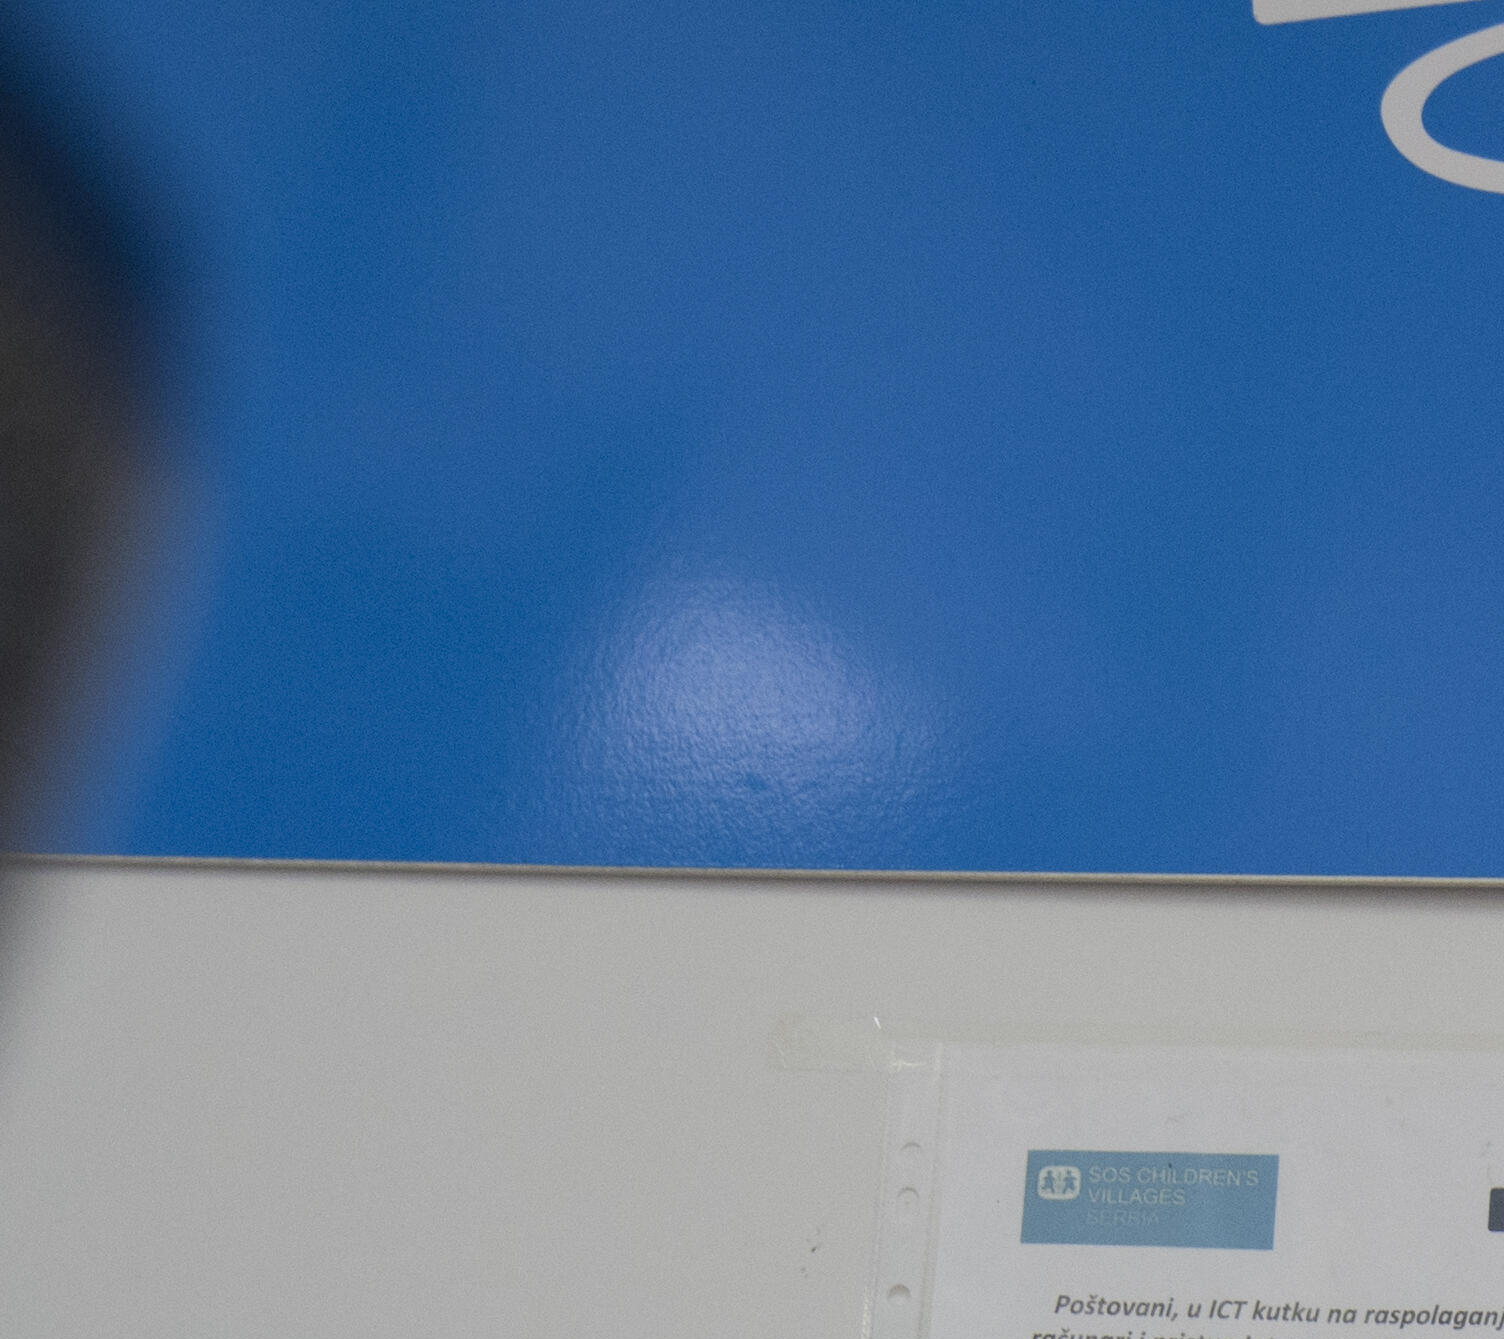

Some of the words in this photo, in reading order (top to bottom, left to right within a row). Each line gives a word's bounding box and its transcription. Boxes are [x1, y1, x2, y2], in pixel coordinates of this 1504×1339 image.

[1087, 1165, 1133, 1184] SOS
[1087, 1187, 1187, 1206] VILLAGES
[1054, 1292, 1181, 1323] Poštovani,
[1186, 1302, 1204, 1321] u
[1208, 1297, 1248, 1321] ICT
[1251, 1298, 1322, 1325] kutku
[1327, 1306, 1359, 1325] na
